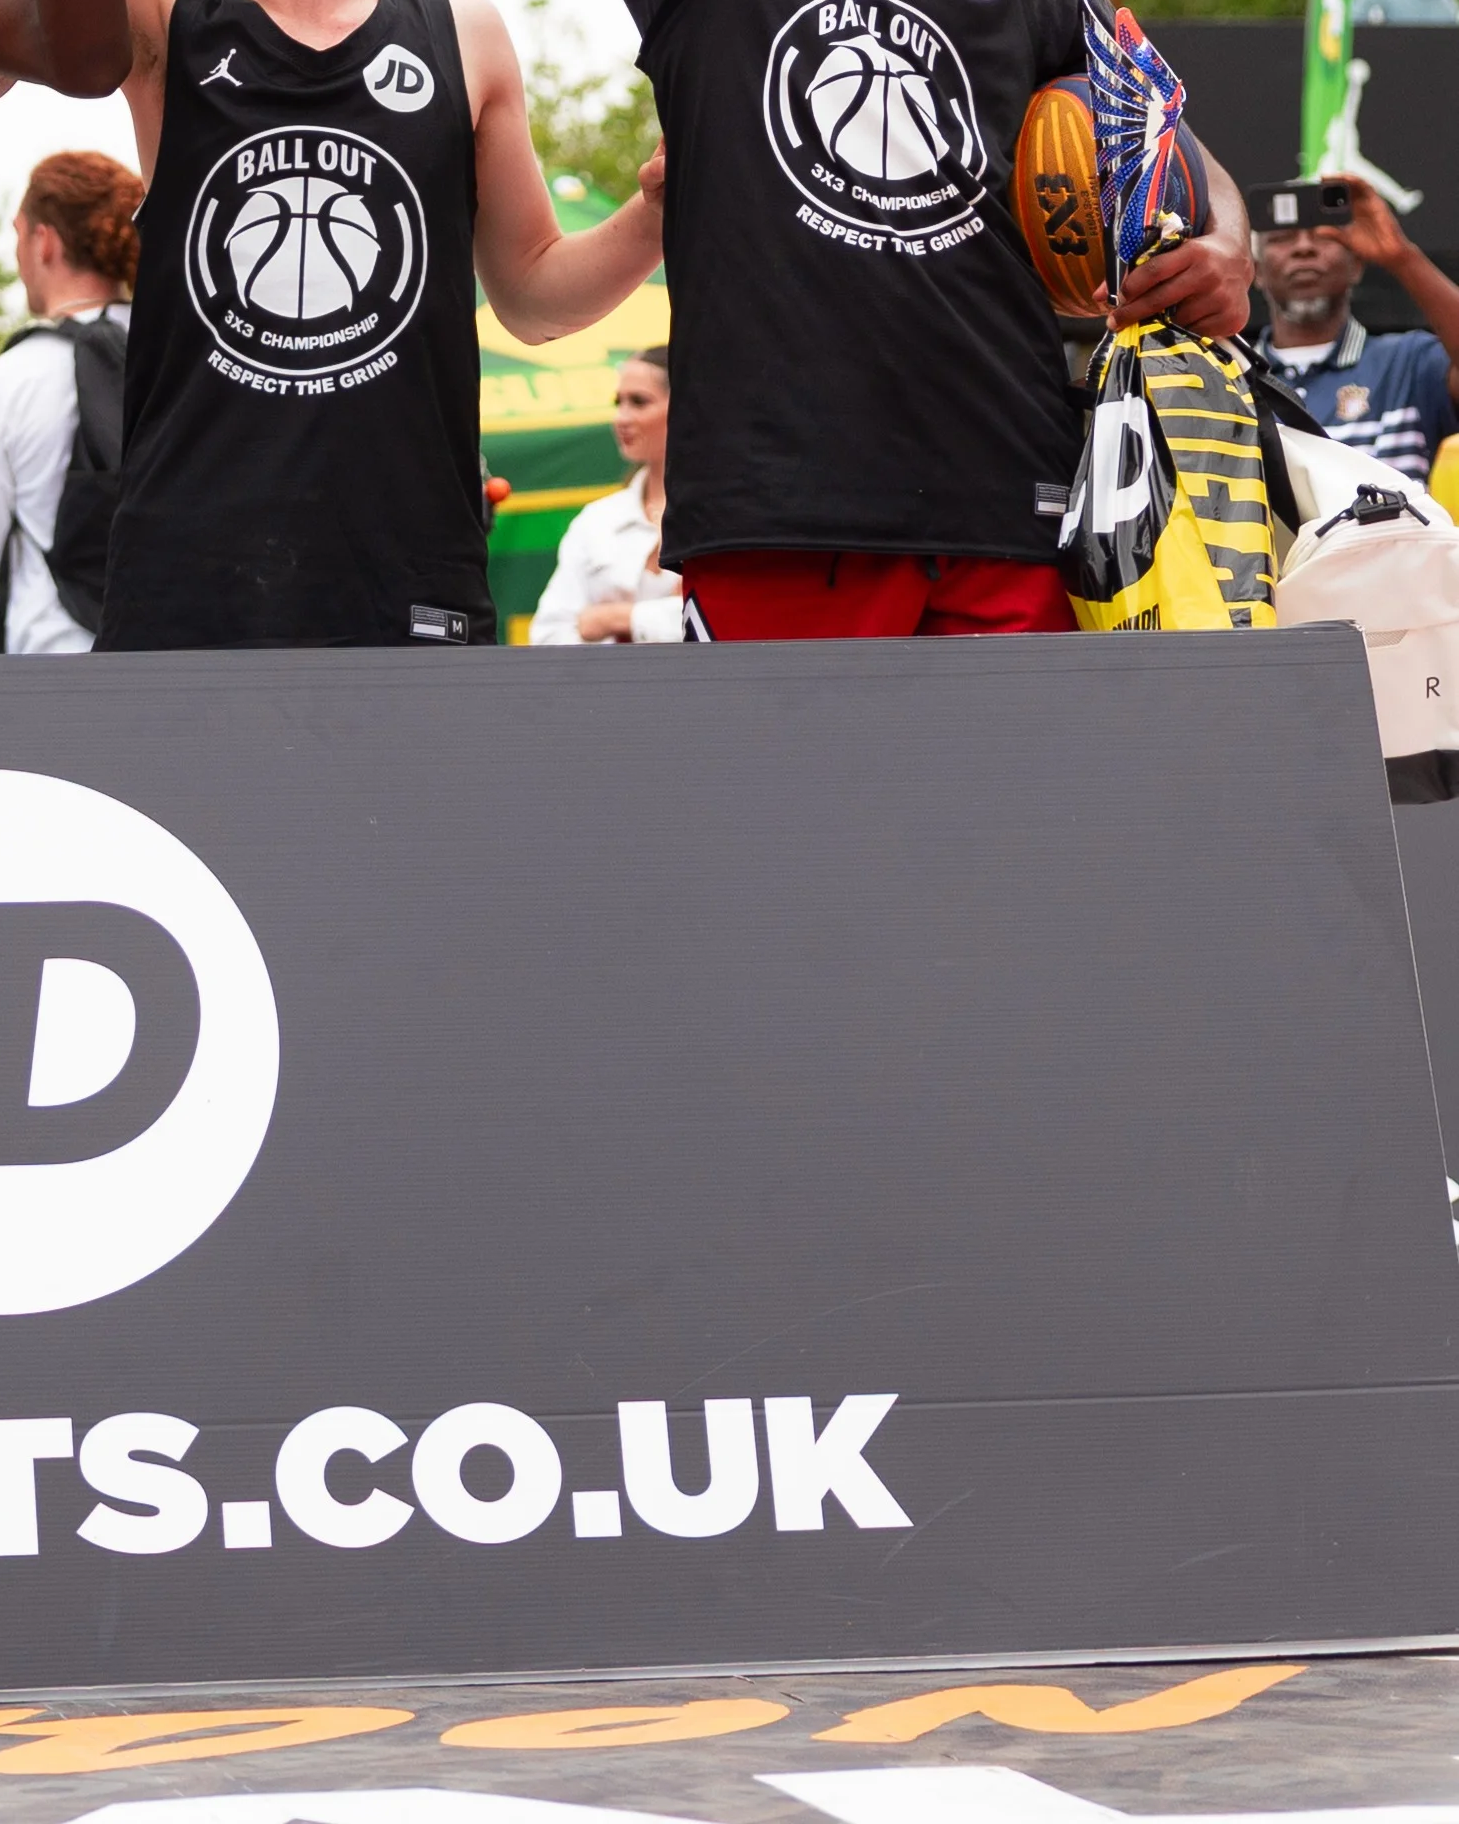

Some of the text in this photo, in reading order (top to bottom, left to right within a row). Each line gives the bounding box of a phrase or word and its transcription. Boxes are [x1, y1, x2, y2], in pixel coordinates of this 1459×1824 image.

[889, 14, 942, 72] OUT
[374, 59, 424, 95] JD
[237, 138, 377, 185] BALL OUT
[810, 163, 846, 192] 3X3
[795, 203, 887, 251] RESPECT
[929, 216, 985, 252] GRIND
[224, 309, 379, 350] 3X3 CHAMPIONSHIP
[207, 349, 398, 395] RESPECT THE GRIND
[452, 619, 463, 635] M
[1426, 676, 1441, 699] R
